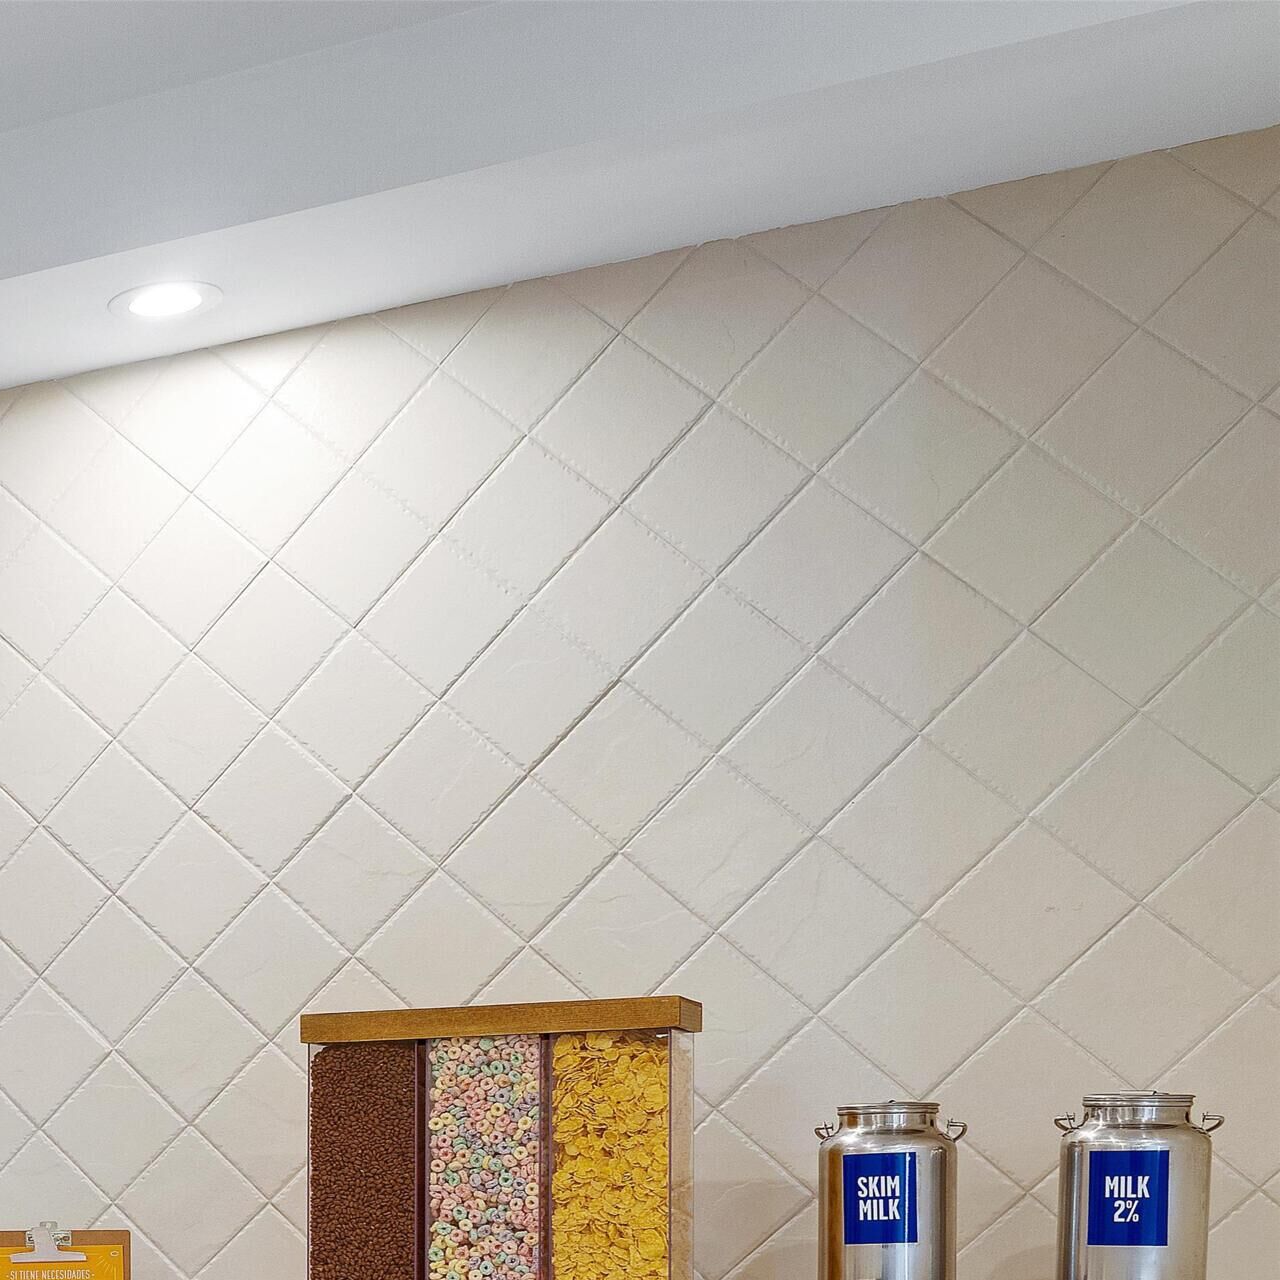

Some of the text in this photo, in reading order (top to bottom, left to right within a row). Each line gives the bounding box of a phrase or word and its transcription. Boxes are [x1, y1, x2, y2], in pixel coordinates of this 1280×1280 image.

[857, 1175, 900, 1198] SKIM
[1104, 1175, 1150, 1198] MILK
[859, 1199, 901, 1221] MILK
[1113, 1200, 1139, 1223] 2%
[10, 1269, 90, 1280] SI TIENE NECESIDADES
